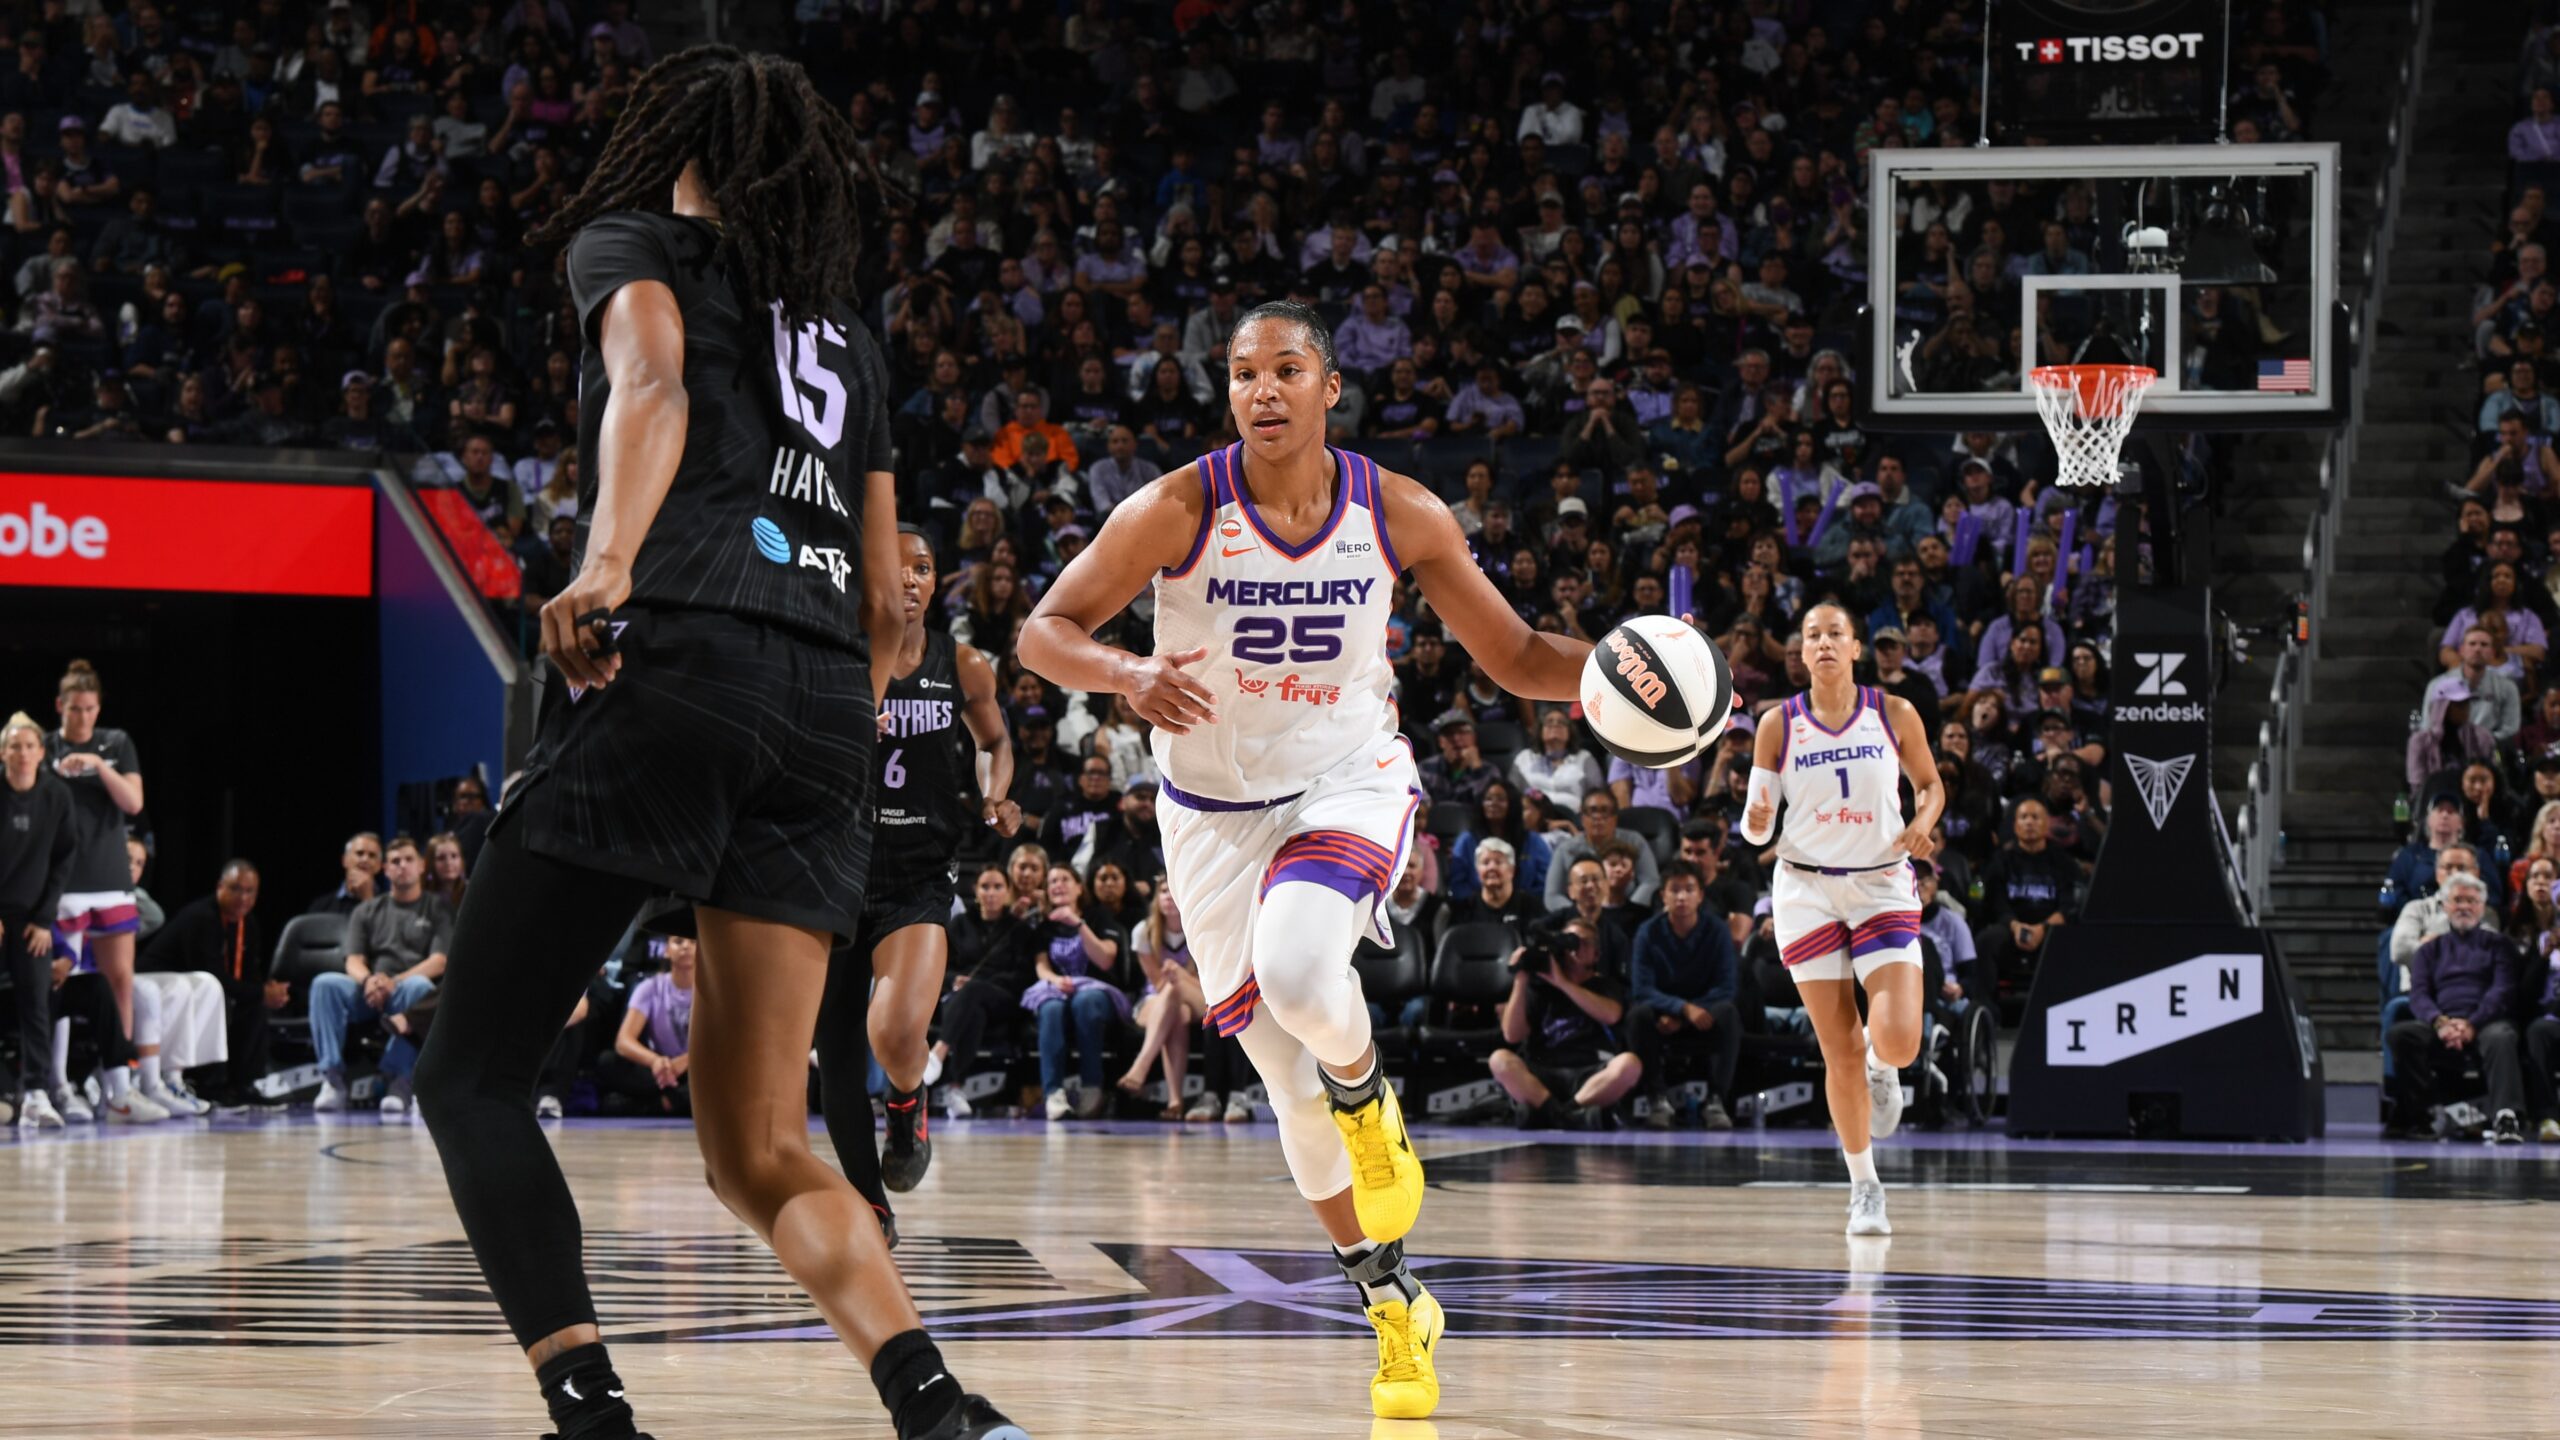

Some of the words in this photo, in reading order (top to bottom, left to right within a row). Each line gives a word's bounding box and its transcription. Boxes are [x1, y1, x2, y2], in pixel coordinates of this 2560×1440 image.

[2066, 33, 2204, 62] TISSOT
[769, 298, 848, 450] 15
[769, 446, 848, 517] HAYE
[0, 502, 109, 559] obe
[1336, 541, 1372, 553] HERO
[799, 544, 852, 594] AT&T
[1206, 577, 1376, 606] MERCURY
[1232, 614, 1345, 664] 25
[1605, 629, 1667, 710] Wilson
[1275, 674, 1341, 705] fry's
[2114, 701, 2205, 722] zendesk
[884, 749, 906, 789] 6
[1795, 745, 1884, 772] MERCURY
[1835, 767, 1850, 799] 1
[880, 807, 905, 817] KAISER
[1837, 807, 1873, 824] fry's
[2067, 968, 2239, 1051] IREN
